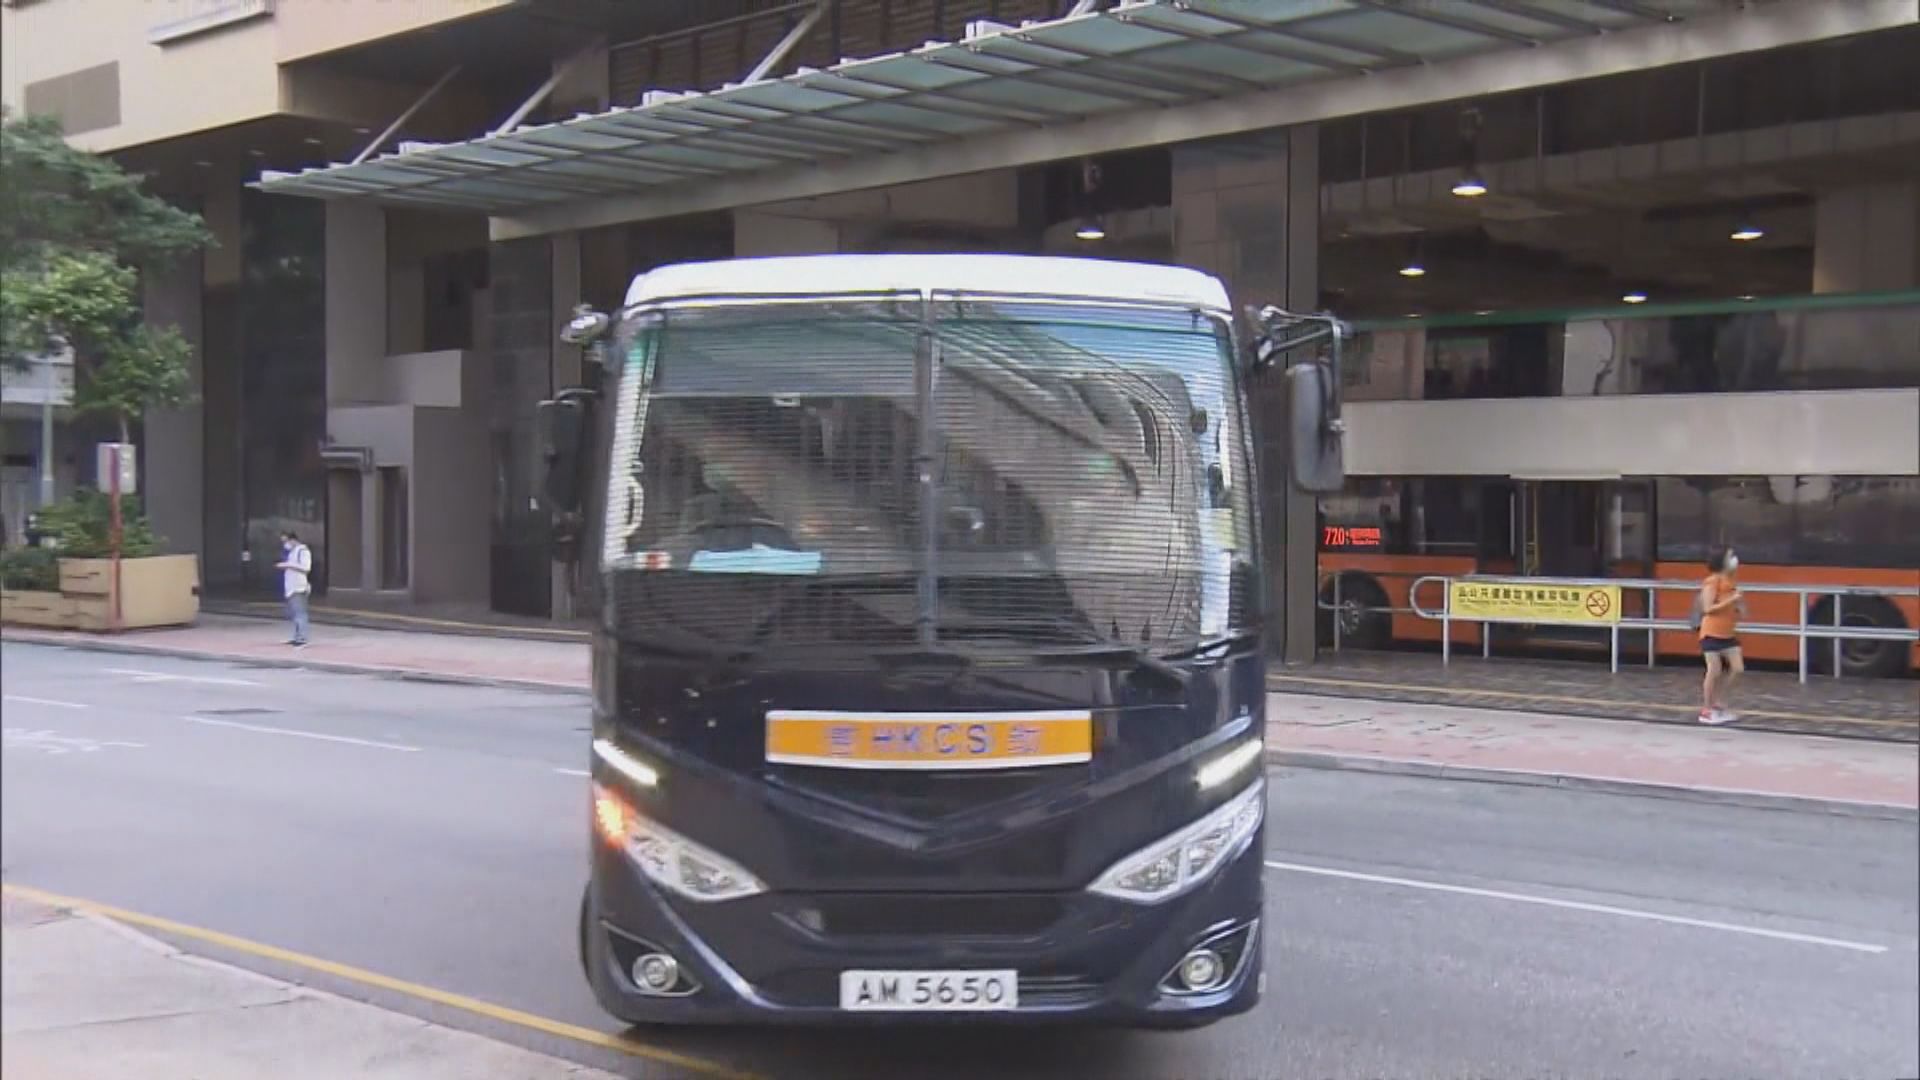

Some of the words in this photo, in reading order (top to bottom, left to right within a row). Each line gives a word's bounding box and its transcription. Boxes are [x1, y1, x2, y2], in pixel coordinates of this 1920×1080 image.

[1325, 527, 1345, 546] 720
[872, 724, 990, 754] HKCS
[857, 977, 901, 1004] AM
[912, 977, 1004, 1004] 5650
